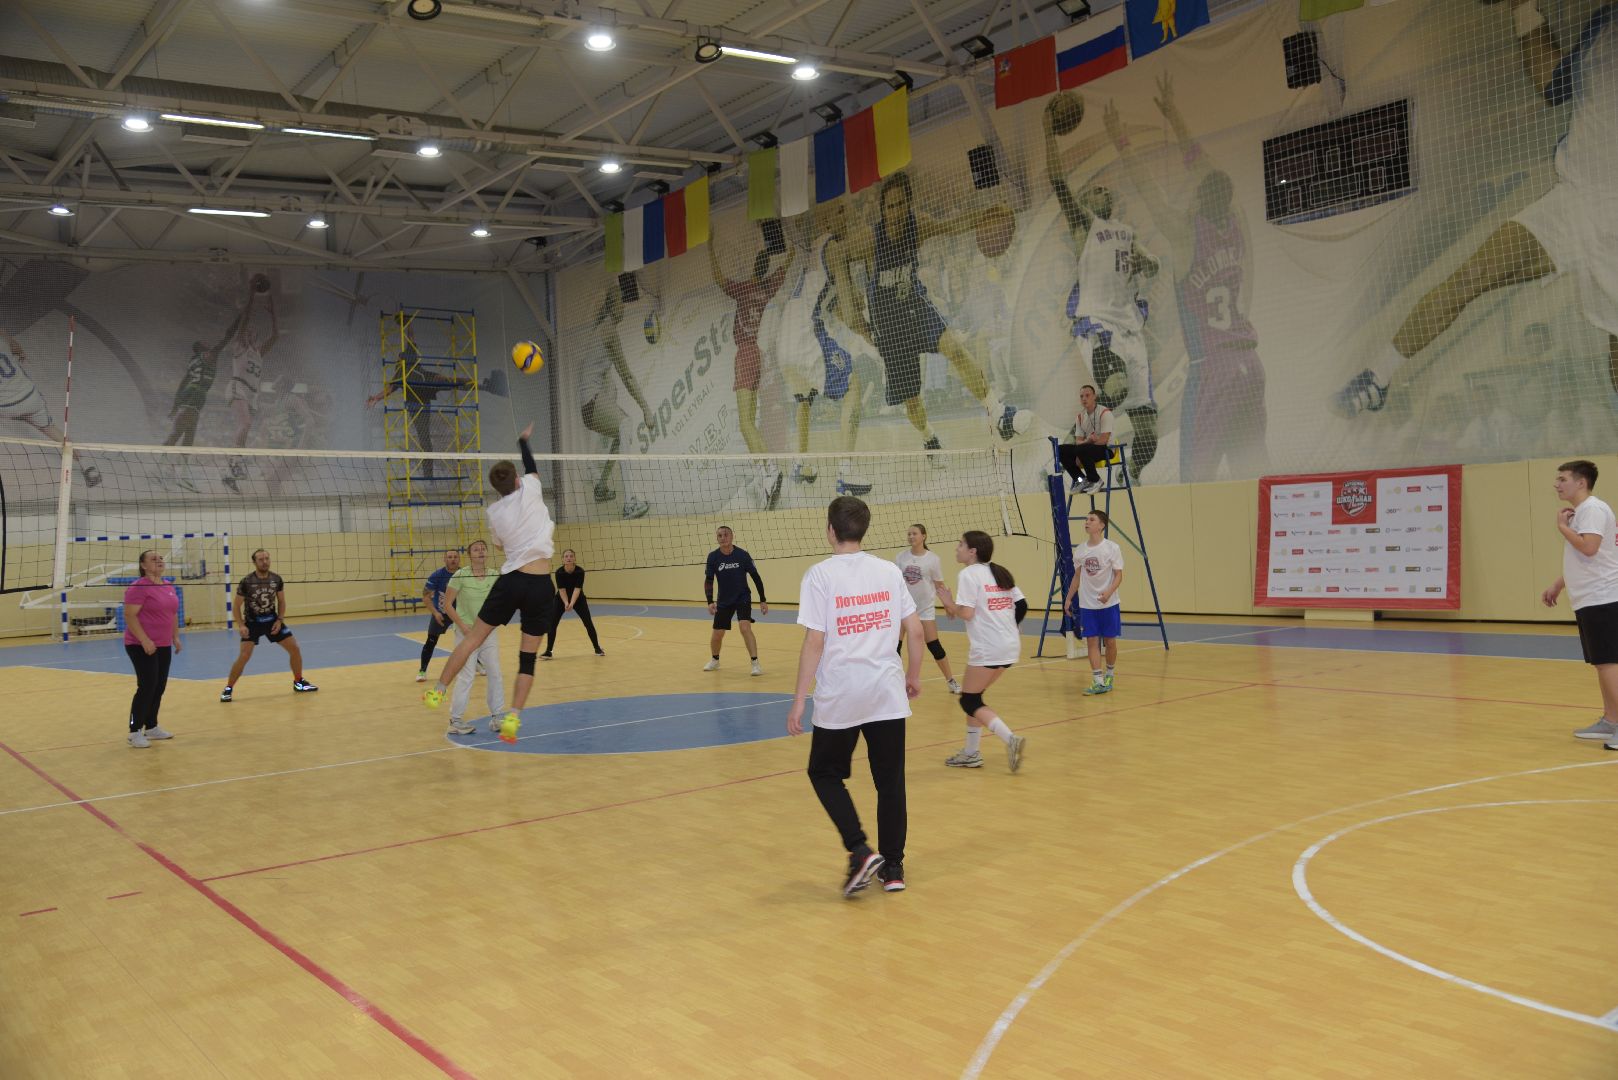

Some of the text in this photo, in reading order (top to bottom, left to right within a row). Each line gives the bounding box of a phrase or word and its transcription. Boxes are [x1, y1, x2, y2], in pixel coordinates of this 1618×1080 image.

[637, 313, 730, 454] SuperSta
[261, 593, 269, 608] 5
[838, 621, 881, 636] СПОРТ
